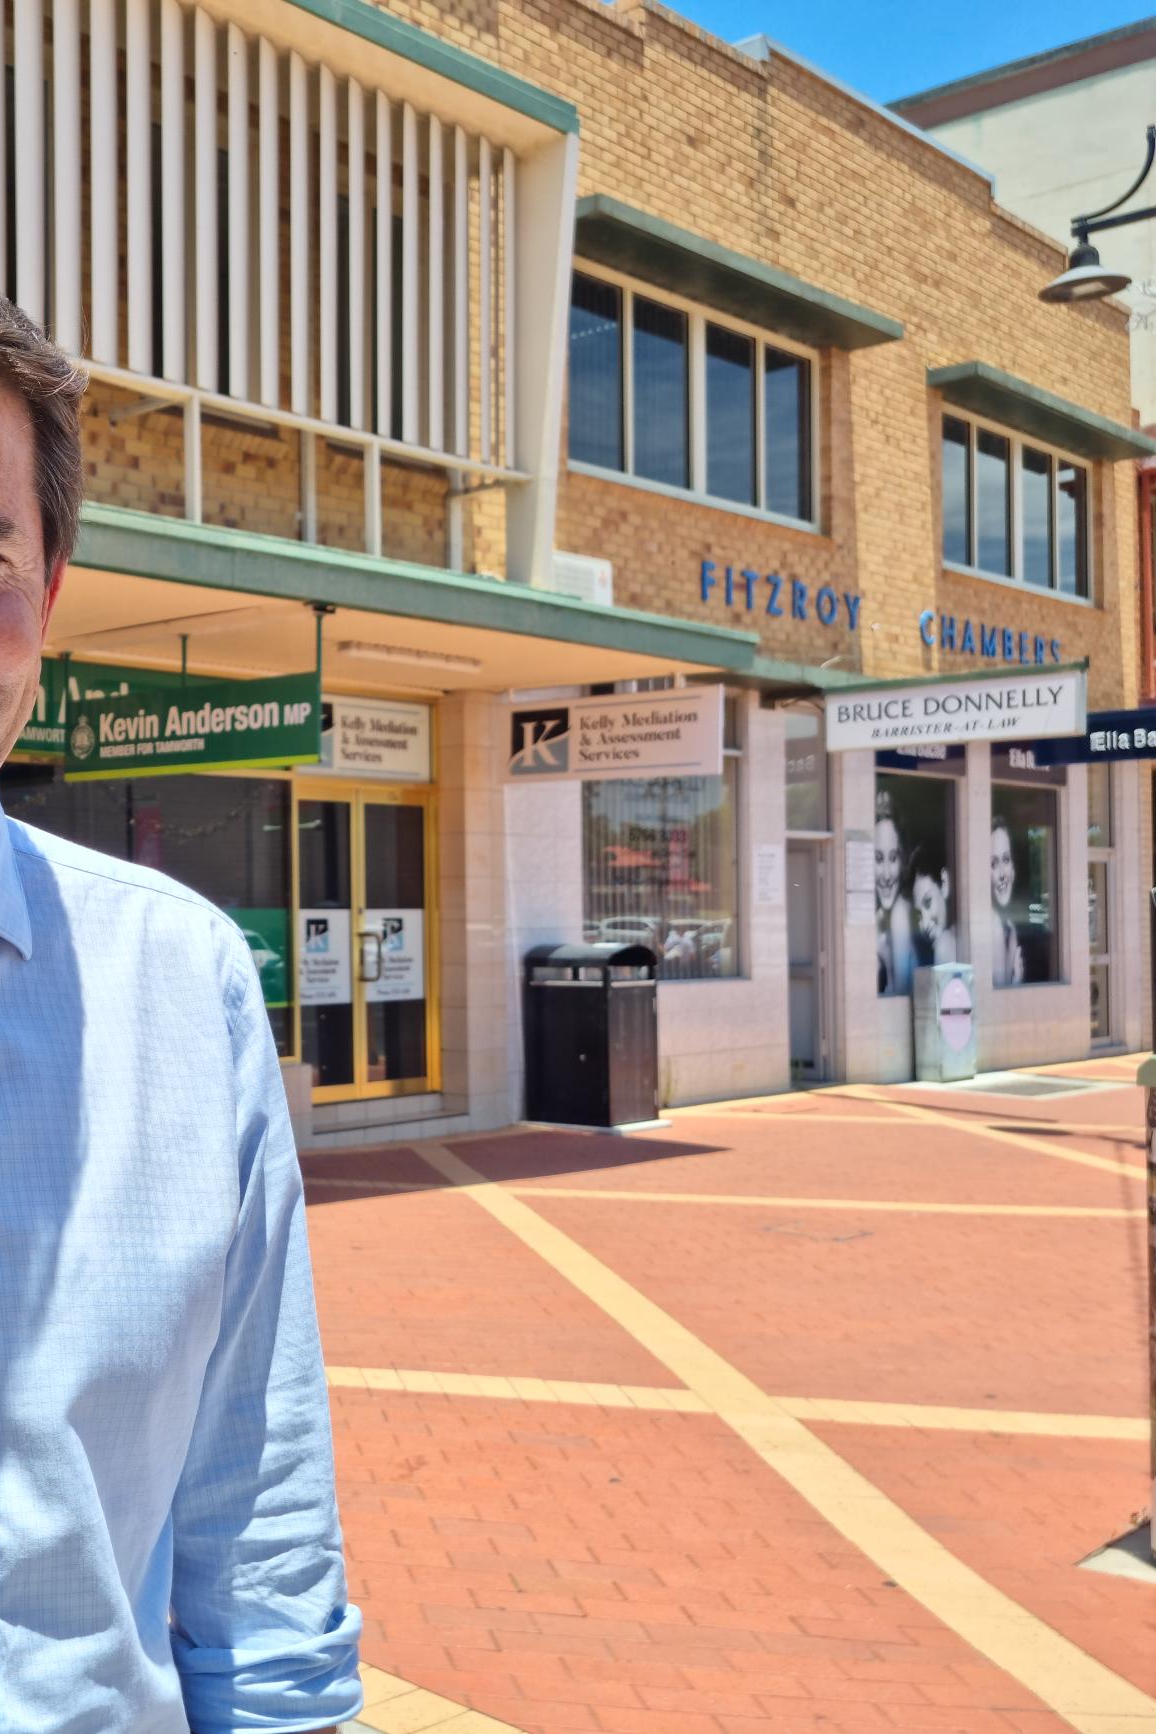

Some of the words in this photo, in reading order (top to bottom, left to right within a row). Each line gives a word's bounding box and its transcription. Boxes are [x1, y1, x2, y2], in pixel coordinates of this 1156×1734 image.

[701, 560, 861, 631] FITZROY
[919, 609, 1061, 664] CHAMBERS
[837, 699, 913, 724] BRUCE
[923, 685, 1063, 716] DONNELLY
[99, 709, 159, 743] Kevin
[165, 702, 280, 737] Anderson
[283, 702, 312, 725] MP
[580, 714, 615, 732] Kelly
[621, 709, 698, 729] Mediation
[519, 718, 564, 767] K
[579, 736, 591, 747] &
[596, 728, 681, 746] Assessment
[1090, 731, 1131, 751] Ella
[99, 744, 135, 758] MEMBER
[137, 742, 154, 755] FOR
[579, 749, 640, 763] Services
